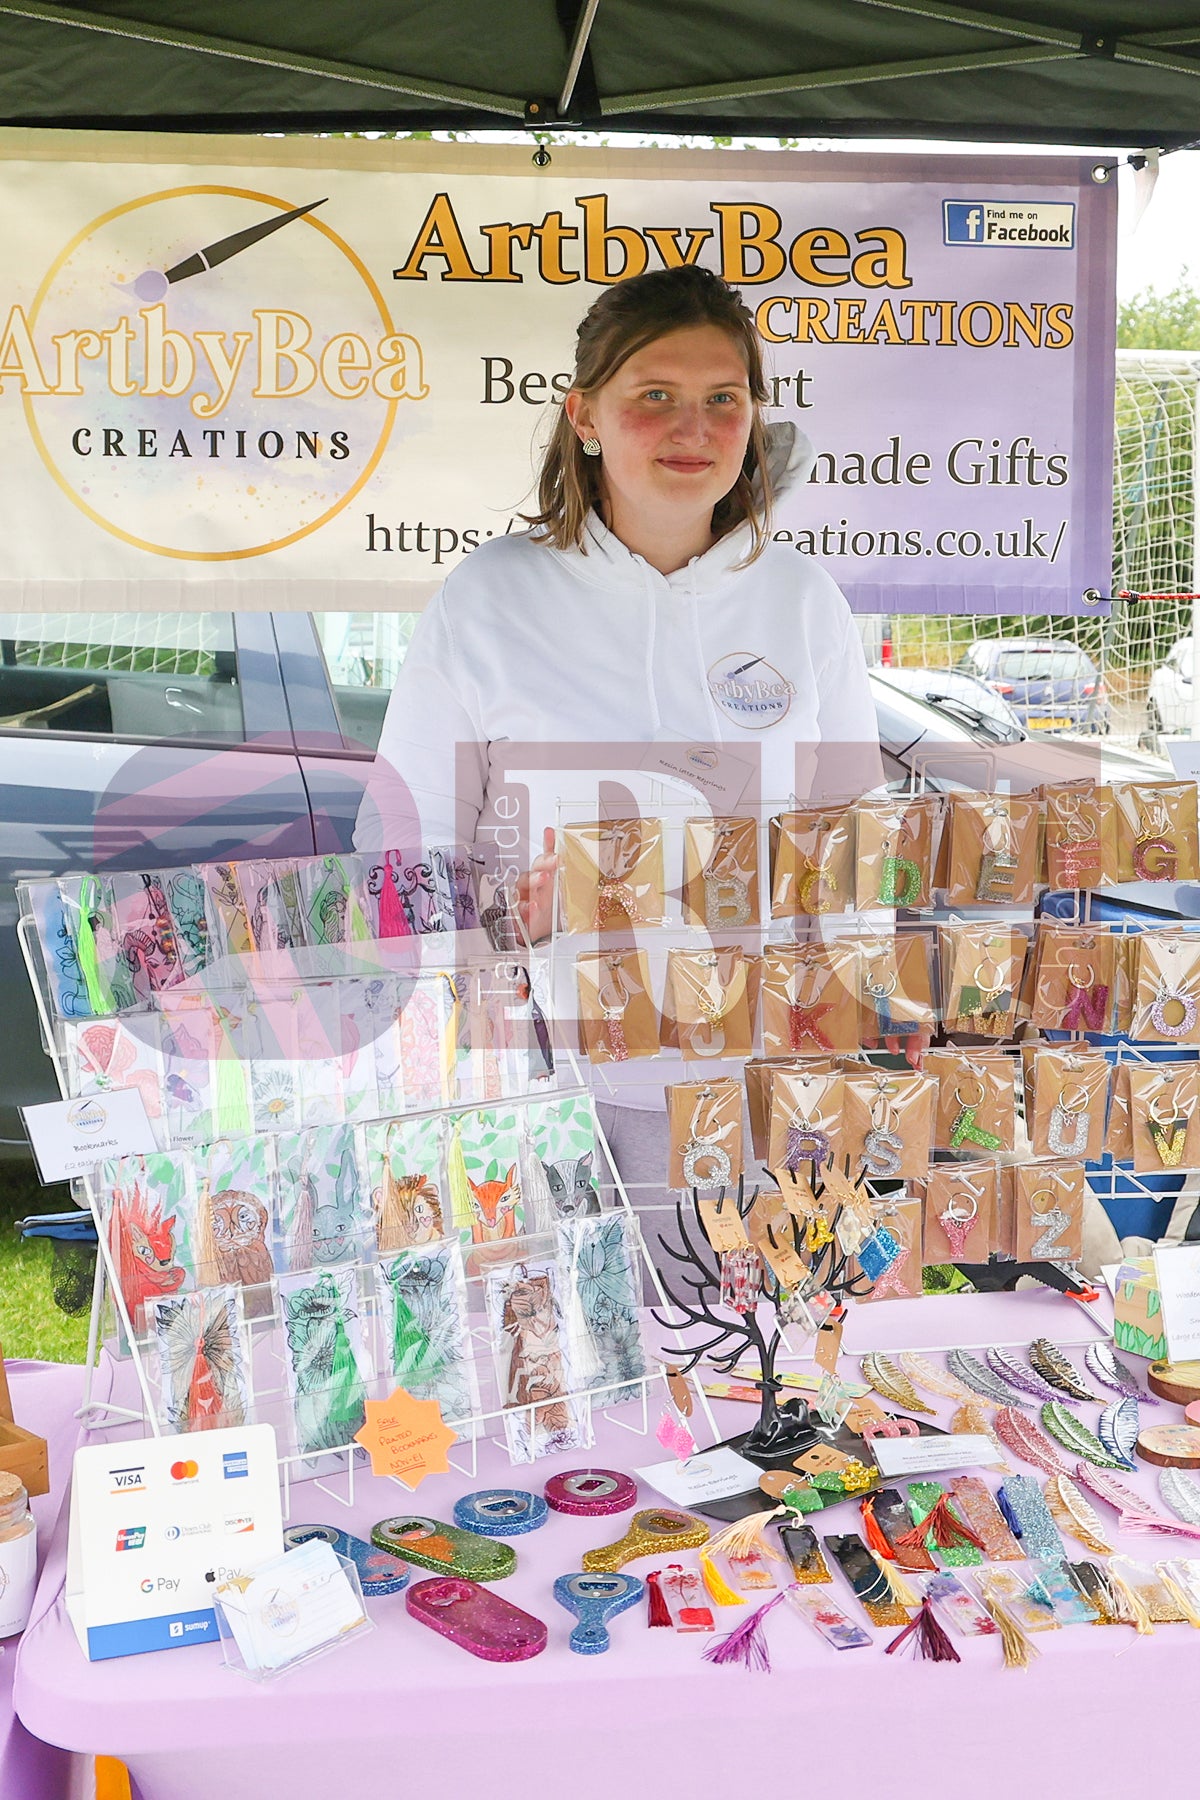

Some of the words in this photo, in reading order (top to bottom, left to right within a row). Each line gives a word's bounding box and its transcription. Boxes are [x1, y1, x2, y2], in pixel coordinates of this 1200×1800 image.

[987, 209, 1006, 219] Find
[1027, 212, 1038, 220] on
[987, 222, 1070, 242] Facebook
[393, 193, 913, 289] ArtbyBea
[755, 296, 1074, 350] CREATIONS
[0, 304, 430, 419] ArtbyBea
[764, 368, 814, 409] rt
[72, 428, 351, 460] CREATIONS
[947, 437, 1069, 487] Gifts
[770, 518, 1069, 564] eations.co.uk/
[878, 857, 921, 906] D
[976, 852, 1018, 903] E
[1132, 837, 1178, 883] G
[705, 876, 752, 930] B
[788, 1002, 837, 1051] K
[1062, 984, 1109, 1030] N
[73, 1138, 119, 1153] Bookmarks
[860, 1130, 904, 1177] S
[1047, 1106, 1091, 1157] U
[683, 1142, 733, 1190] Q
[1030, 1212, 1072, 1260] Z
[376, 1416, 400, 1425] SALE
[115, 1473, 142, 1487] VISA
[157, 1577, 181, 1592] Pay
